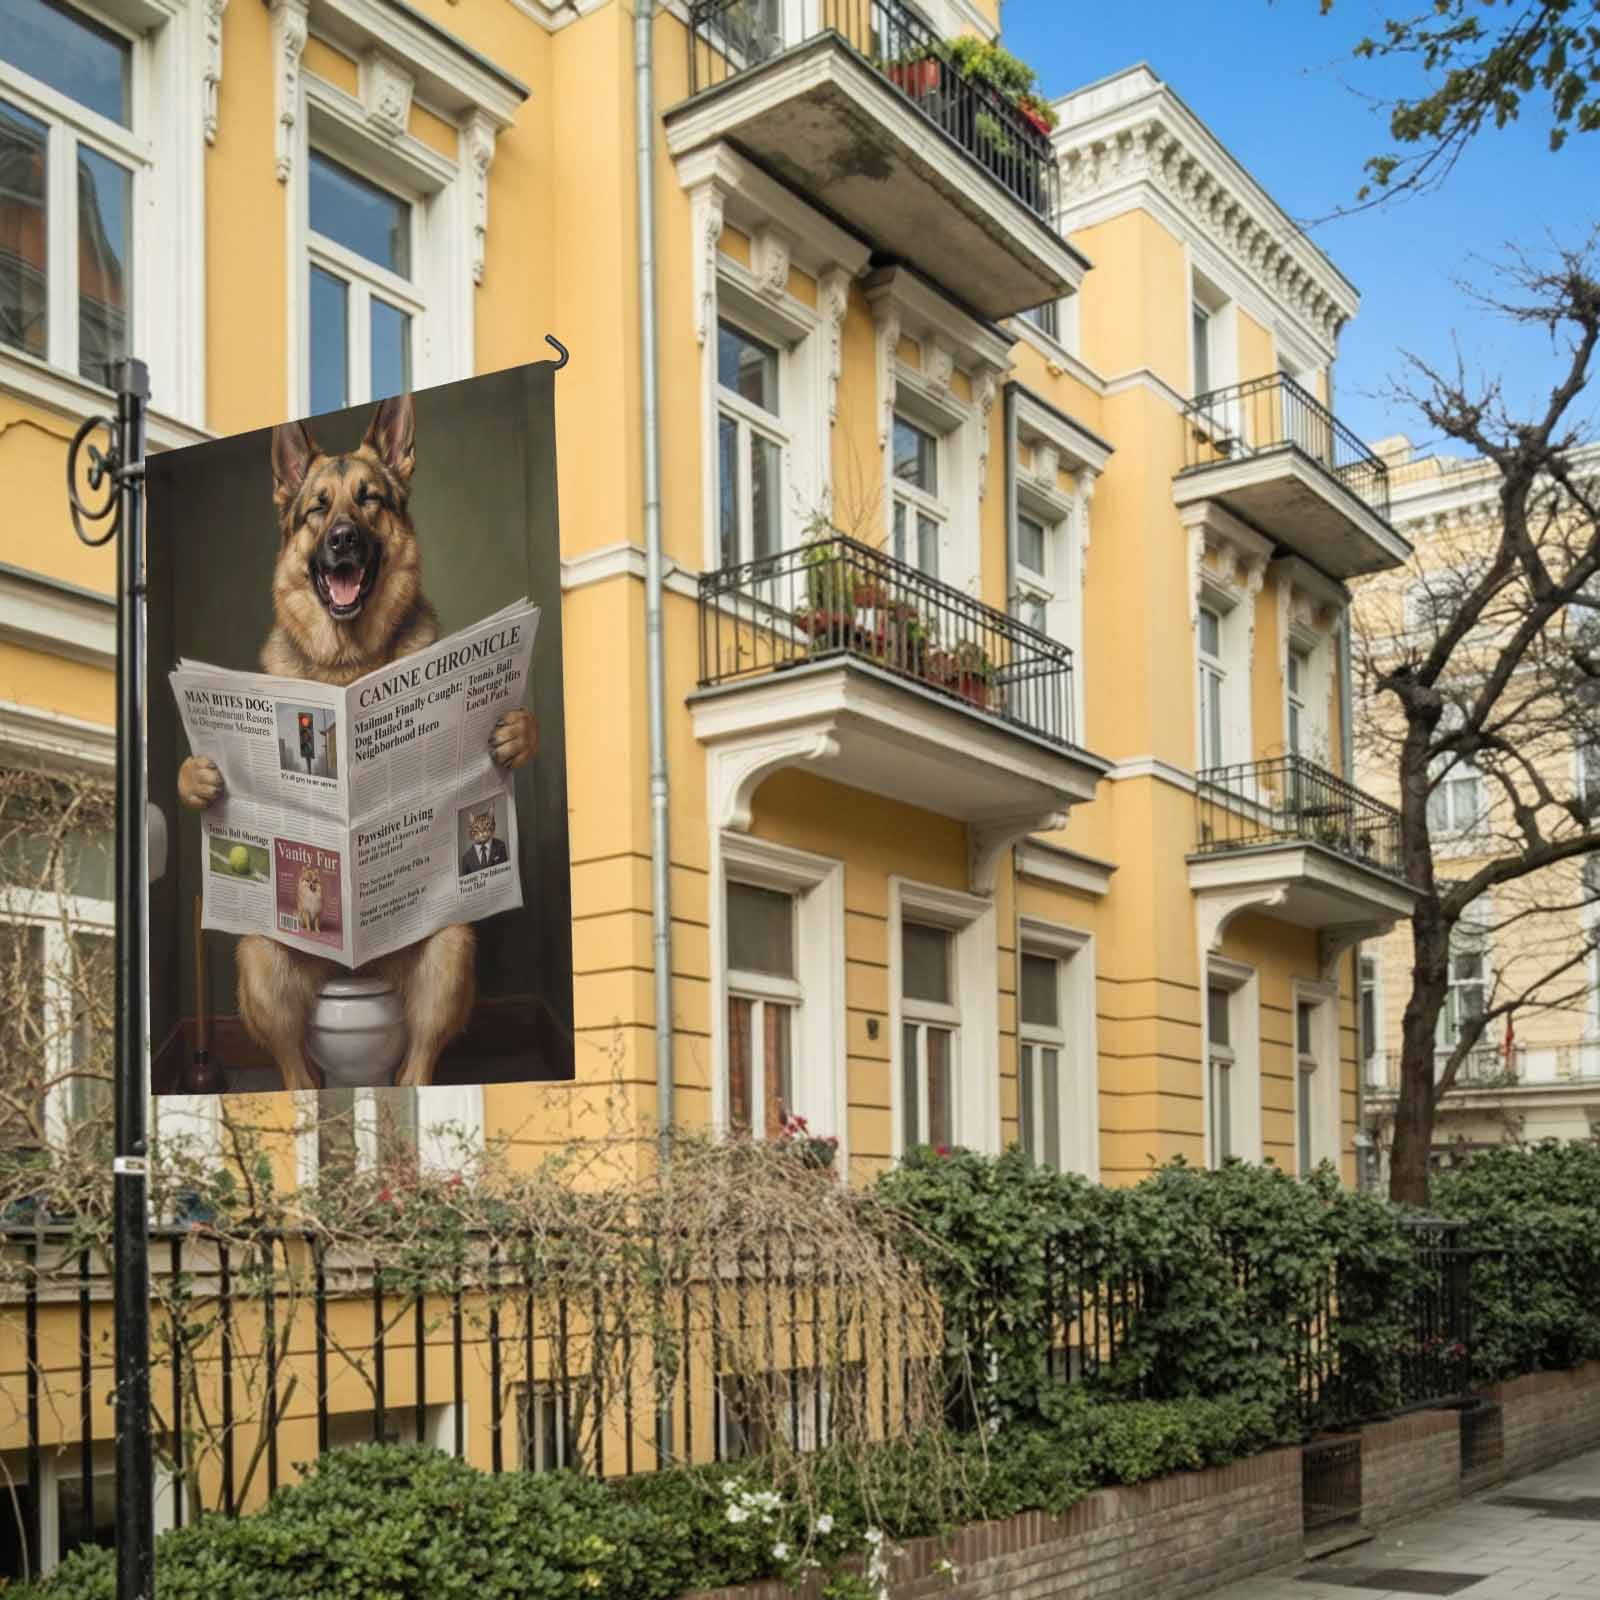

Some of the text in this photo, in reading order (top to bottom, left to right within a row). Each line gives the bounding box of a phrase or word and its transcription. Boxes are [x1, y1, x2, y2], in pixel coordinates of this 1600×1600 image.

[360, 625, 520, 708] CANINE CHRONICLE
[469, 658, 512, 685] Tennis Ball
[466, 670, 520, 699] Shortage Hits
[184, 689, 273, 713] MAN BITES DOG:
[354, 682, 462, 736] Mailman Finally Caught:
[466, 686, 510, 712] Local Park
[246, 711, 274, 726] Resorts
[355, 718, 414, 750] Dog Hailed as
[355, 728, 416, 762] Neighborhood
[418, 720, 440, 736] Hero
[208, 824, 268, 846] Tennis Ball Shortage
[358, 808, 433, 847] Pawsitive Living
[278, 842, 338, 870] Vanity Fur
